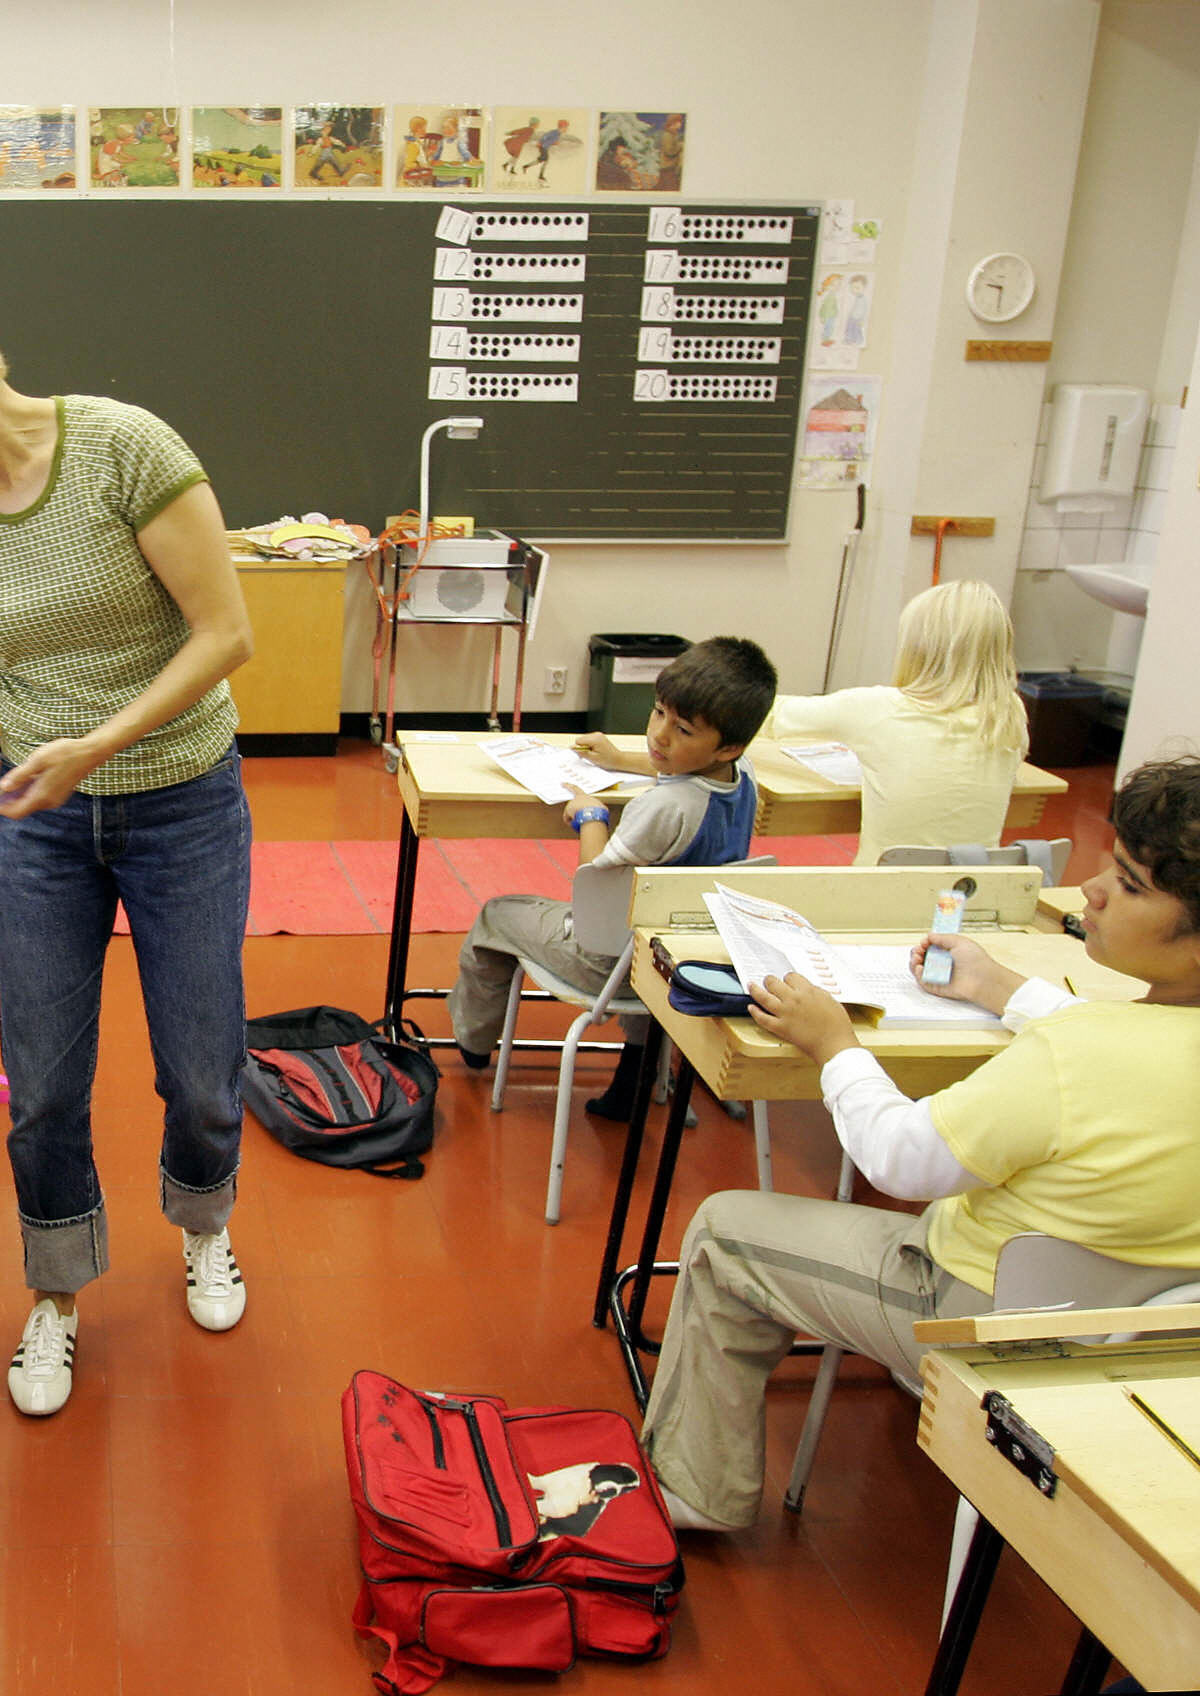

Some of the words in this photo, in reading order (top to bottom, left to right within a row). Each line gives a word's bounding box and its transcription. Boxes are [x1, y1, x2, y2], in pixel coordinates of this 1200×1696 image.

[443, 211, 470, 240] 11
[652, 213, 677, 238] 16
[440, 251, 468, 277] 12
[648, 254, 673, 280] 17
[439, 292, 465, 318] 13
[646, 291, 671, 317] 18
[435, 331, 461, 356] 14
[644, 332, 669, 357] 19
[433, 371, 461, 396] 15
[634, 373, 667, 399] 20
